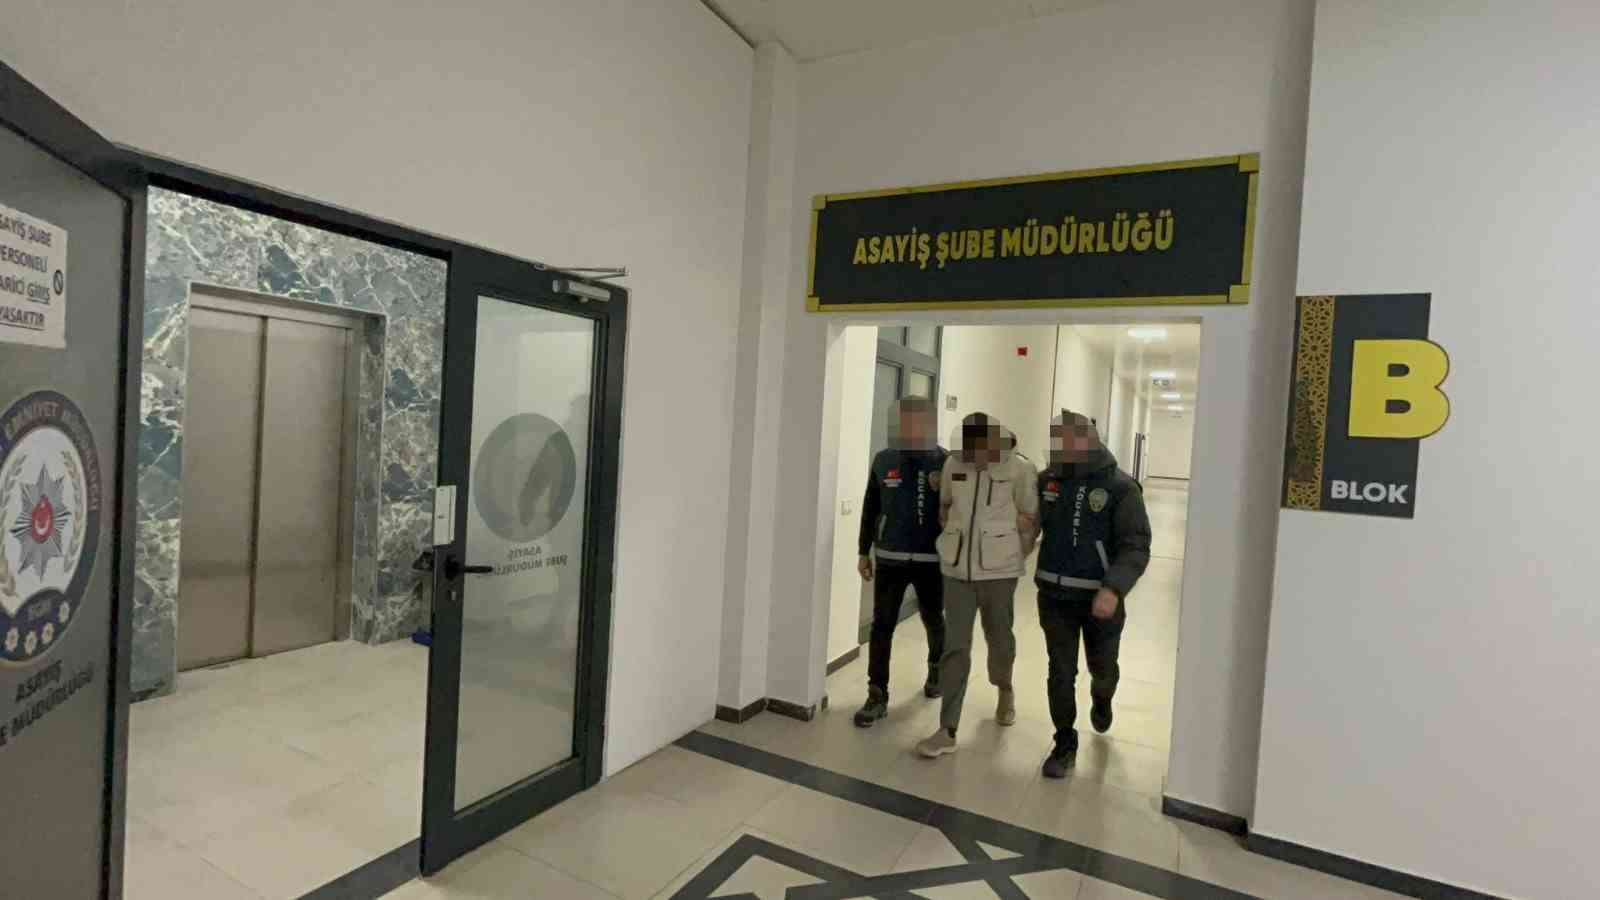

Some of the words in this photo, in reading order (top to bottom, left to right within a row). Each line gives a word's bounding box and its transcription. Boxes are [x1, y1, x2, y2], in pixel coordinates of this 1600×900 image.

[853, 226, 930, 270] ASAYİŞ
[935, 228, 995, 269] ŞUBE
[1000, 208, 1174, 259] MÜDÜRLÜĞÜ
[1348, 339, 1450, 440] B
[1330, 479, 1409, 504] BLOK
